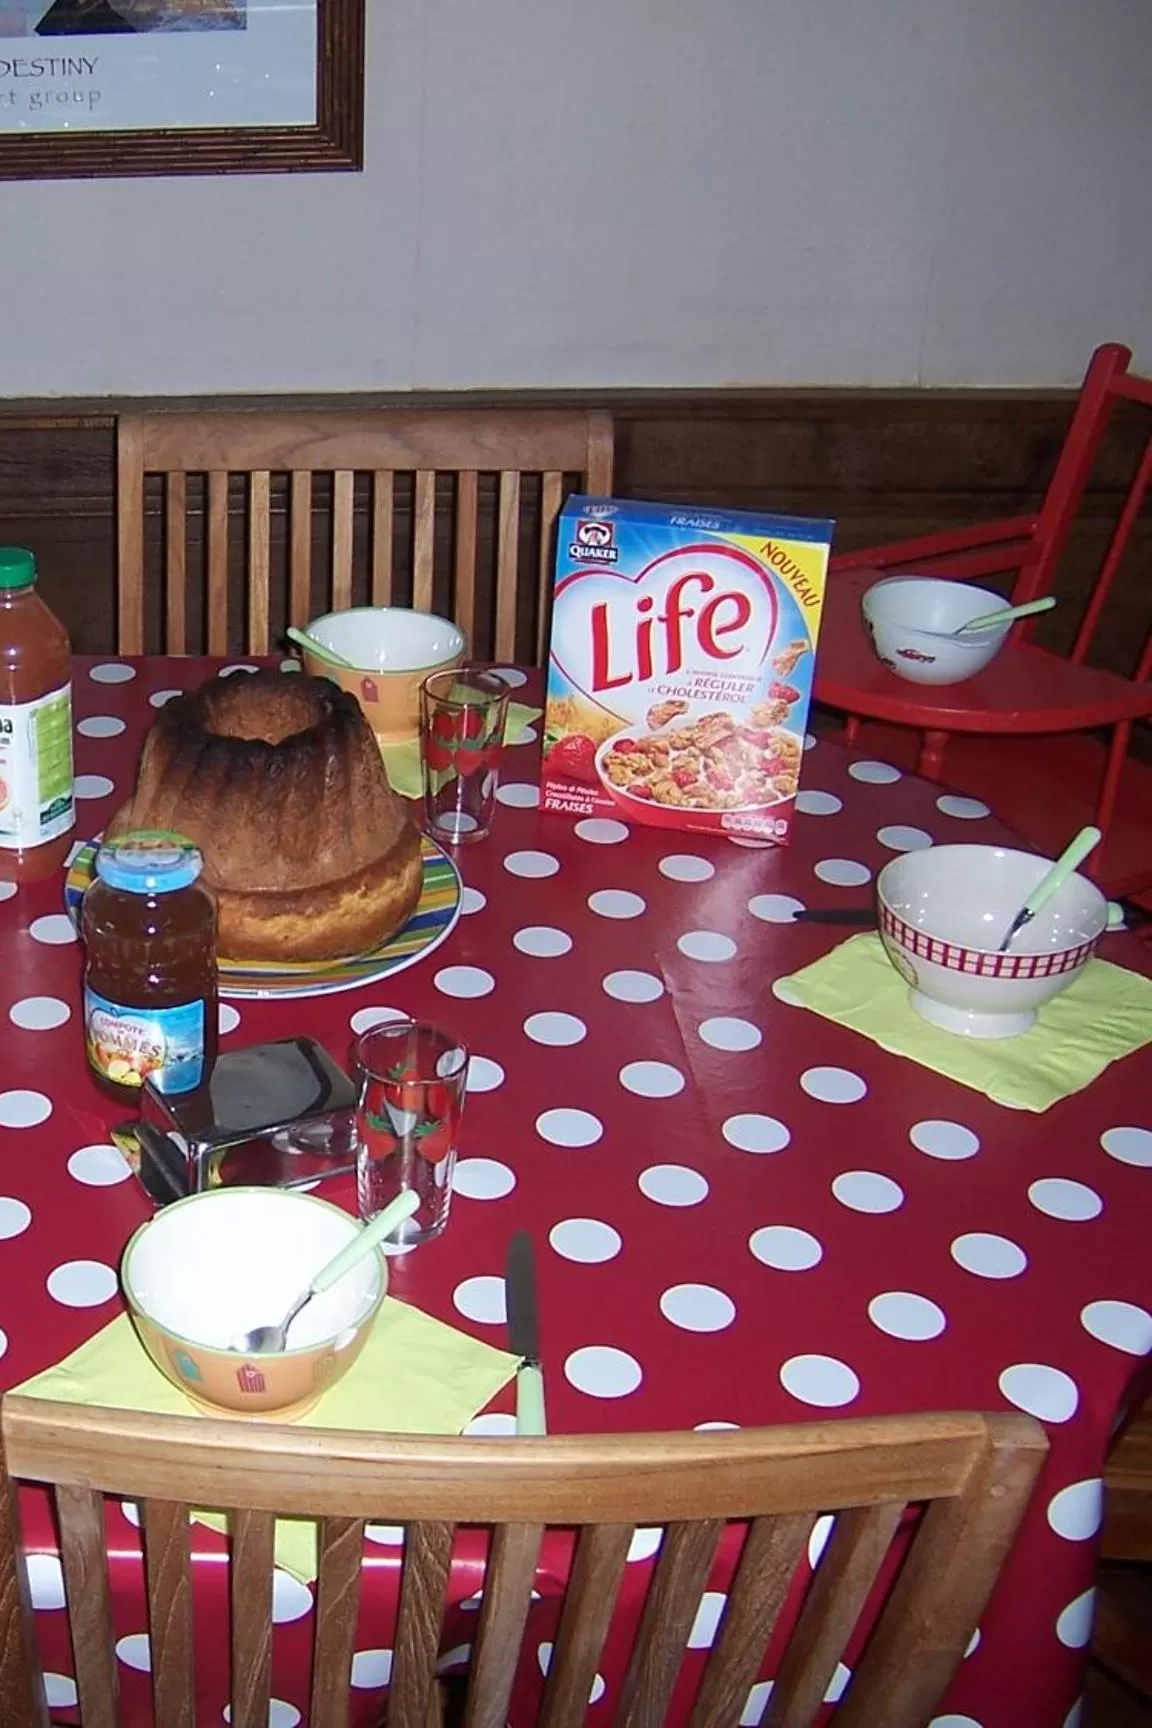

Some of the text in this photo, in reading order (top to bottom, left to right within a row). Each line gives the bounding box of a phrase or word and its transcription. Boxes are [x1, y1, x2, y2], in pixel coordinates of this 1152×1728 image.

[29, 89, 101, 111] group
[570, 545, 617, 560] QUAKER
[759, 540, 821, 608] NOUVEAU
[591, 571, 752, 694] Life
[545, 797, 594, 814] FRAISES
